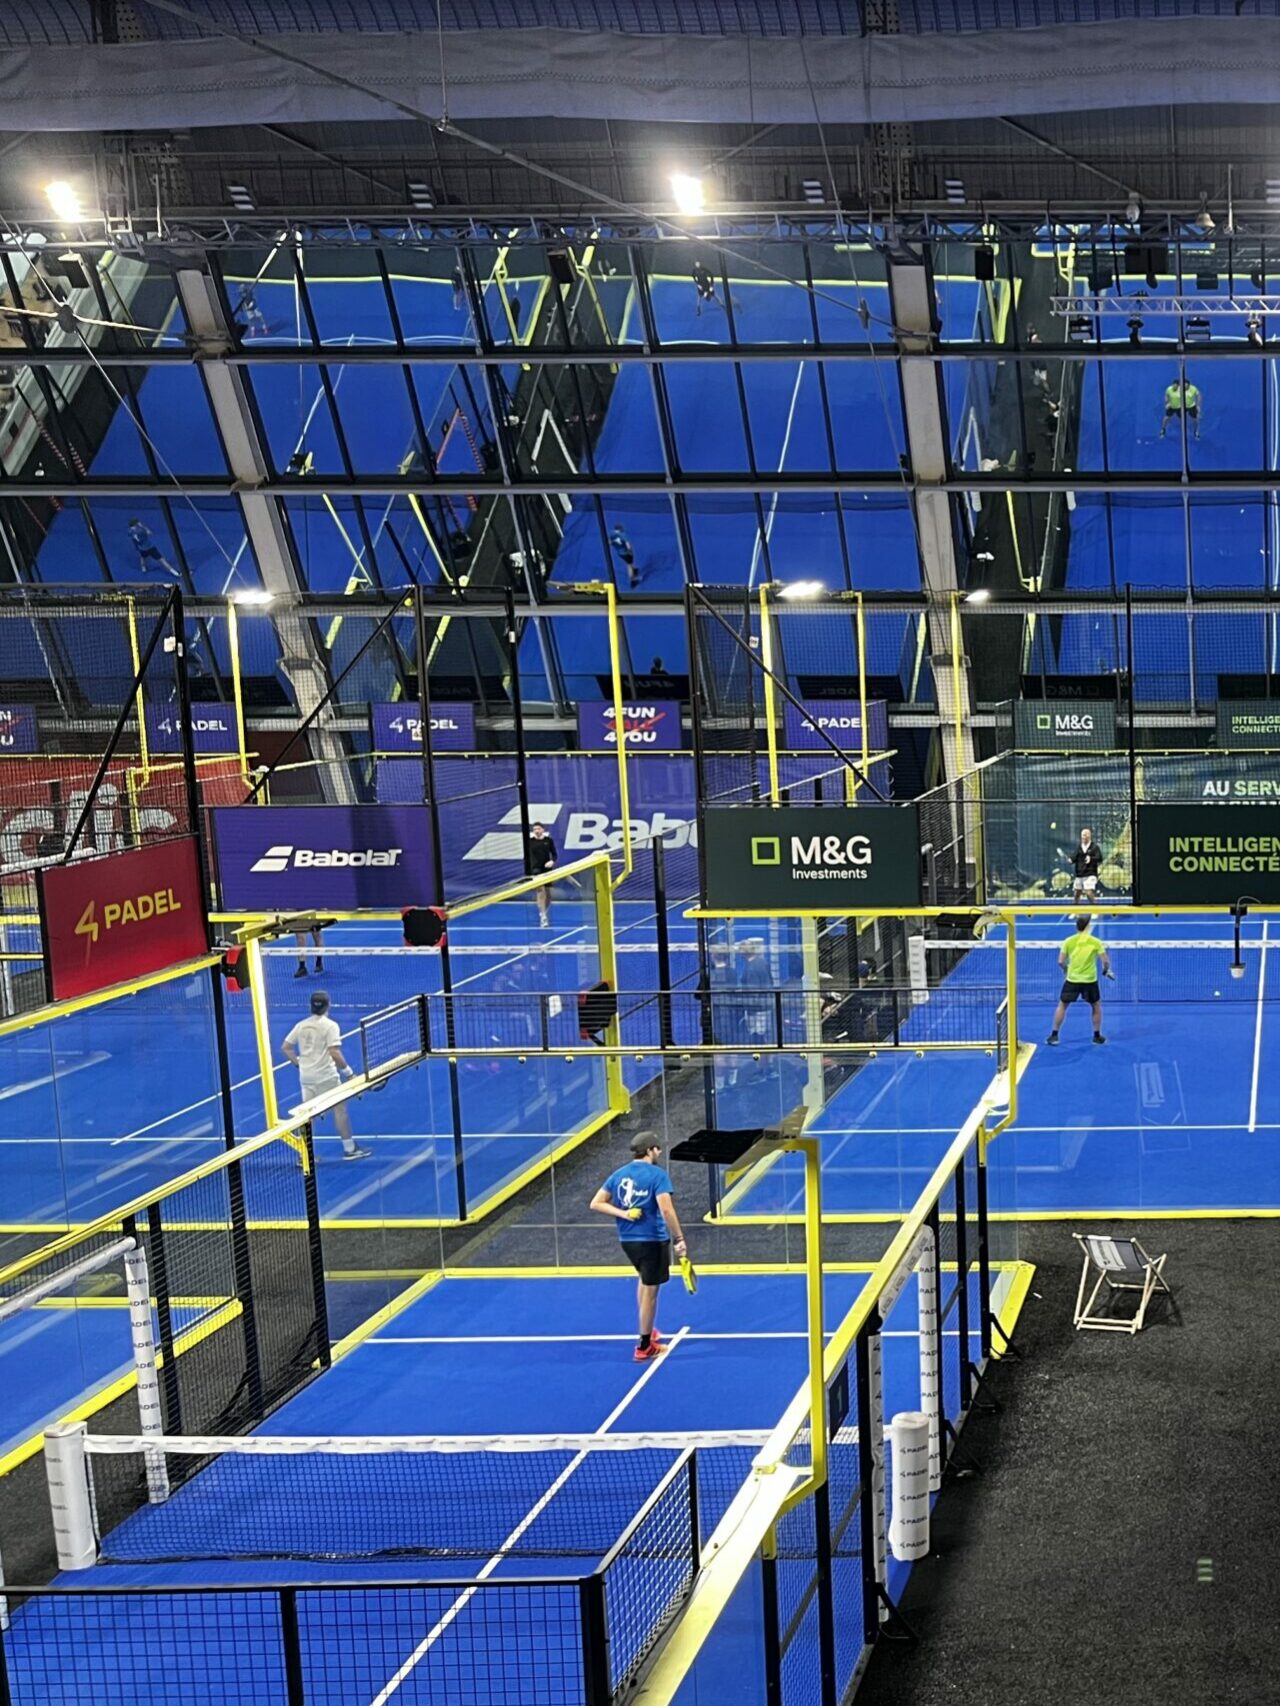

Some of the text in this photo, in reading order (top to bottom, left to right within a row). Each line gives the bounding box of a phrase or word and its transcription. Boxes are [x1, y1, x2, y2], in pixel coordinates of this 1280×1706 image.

[818, 718, 863, 728] PADE
[1055, 715, 1093, 729] M&G
[1203, 781, 1230, 796] AU
[792, 836, 872, 865] M&G
[293, 849, 403, 868] Babolat
[792, 868, 868, 879] Investments
[104, 889, 182, 930] PADEL
